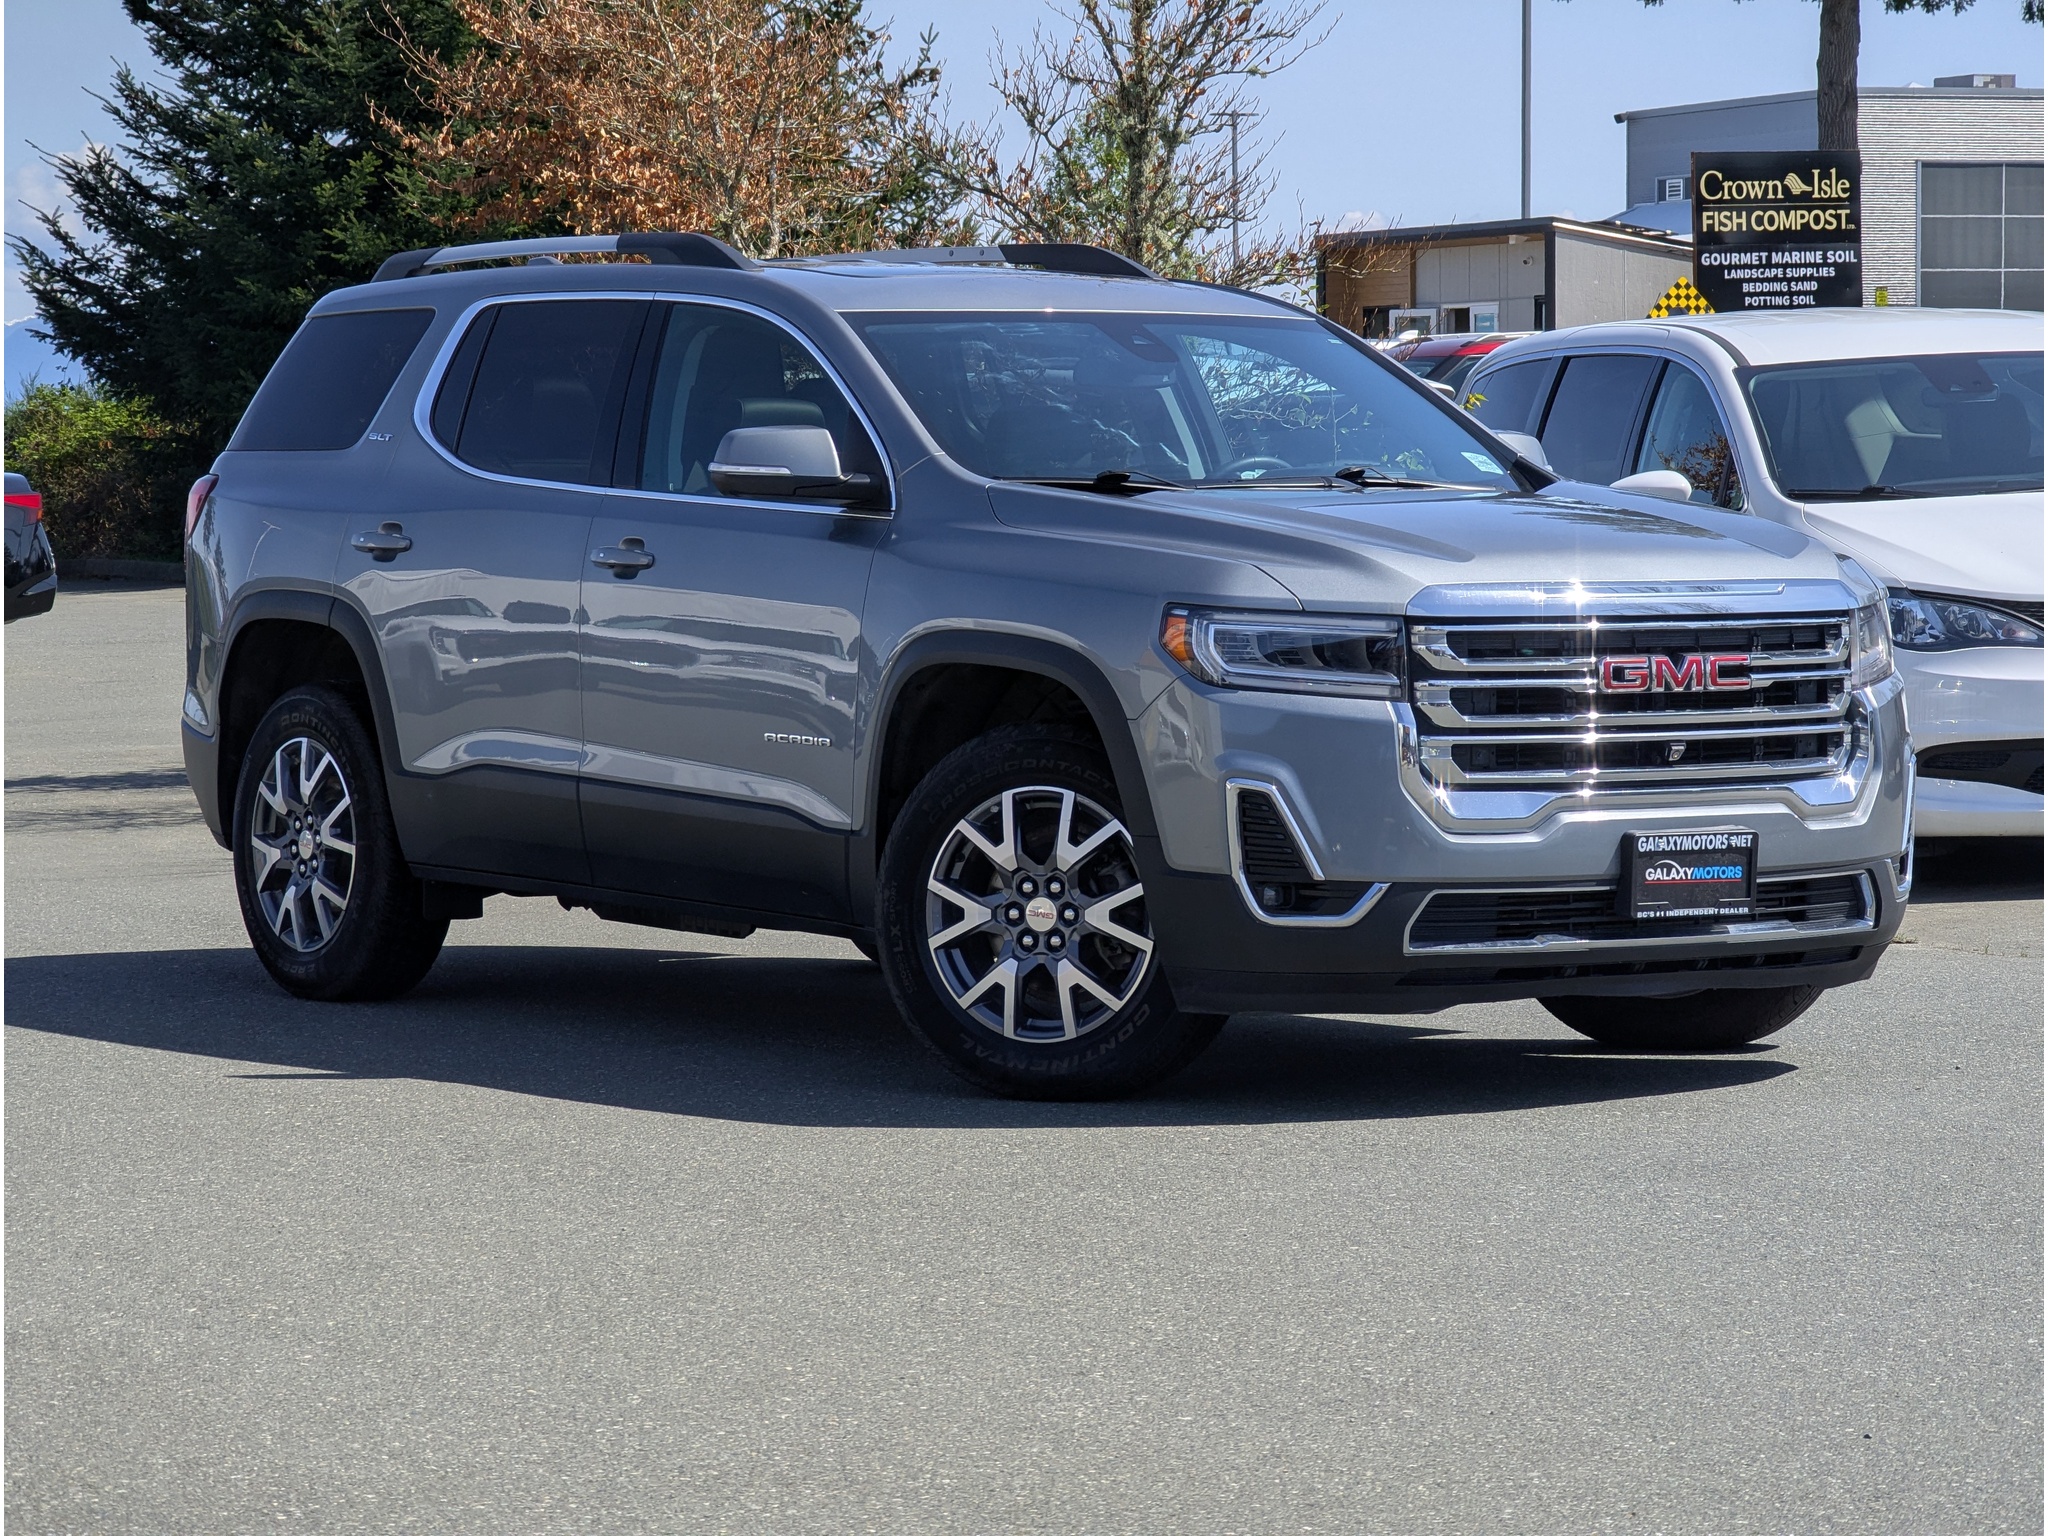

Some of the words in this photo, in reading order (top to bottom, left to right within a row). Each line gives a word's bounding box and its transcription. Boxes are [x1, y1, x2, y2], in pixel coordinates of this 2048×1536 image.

[1700, 170, 1784, 200] Crown
[1812, 167, 1850, 199] Isle
[1702, 210, 1747, 232] FISH
[1751, 209, 1850, 232] COMPOST
[1701, 252, 1769, 266] GOURMET
[1772, 251, 1823, 265] MARINE
[1826, 250, 1858, 264] SOIL
[1724, 268, 1784, 279] LANDSCAPE
[1786, 267, 1836, 278] SUPPLIES
[1742, 282, 1788, 293] BEDDING
[1790, 281, 1818, 292] SAND
[1745, 296, 1790, 307] POTTING
[1792, 295, 1816, 305] SOIL
[369, 432, 393, 442] SLT
[1599, 654, 1751, 694] GMC
[764, 732, 832, 747] ACADIA
[1645, 866, 1742, 881] GALAXYMOTORS
[1666, 908, 1719, 917] INDEPENDENT
